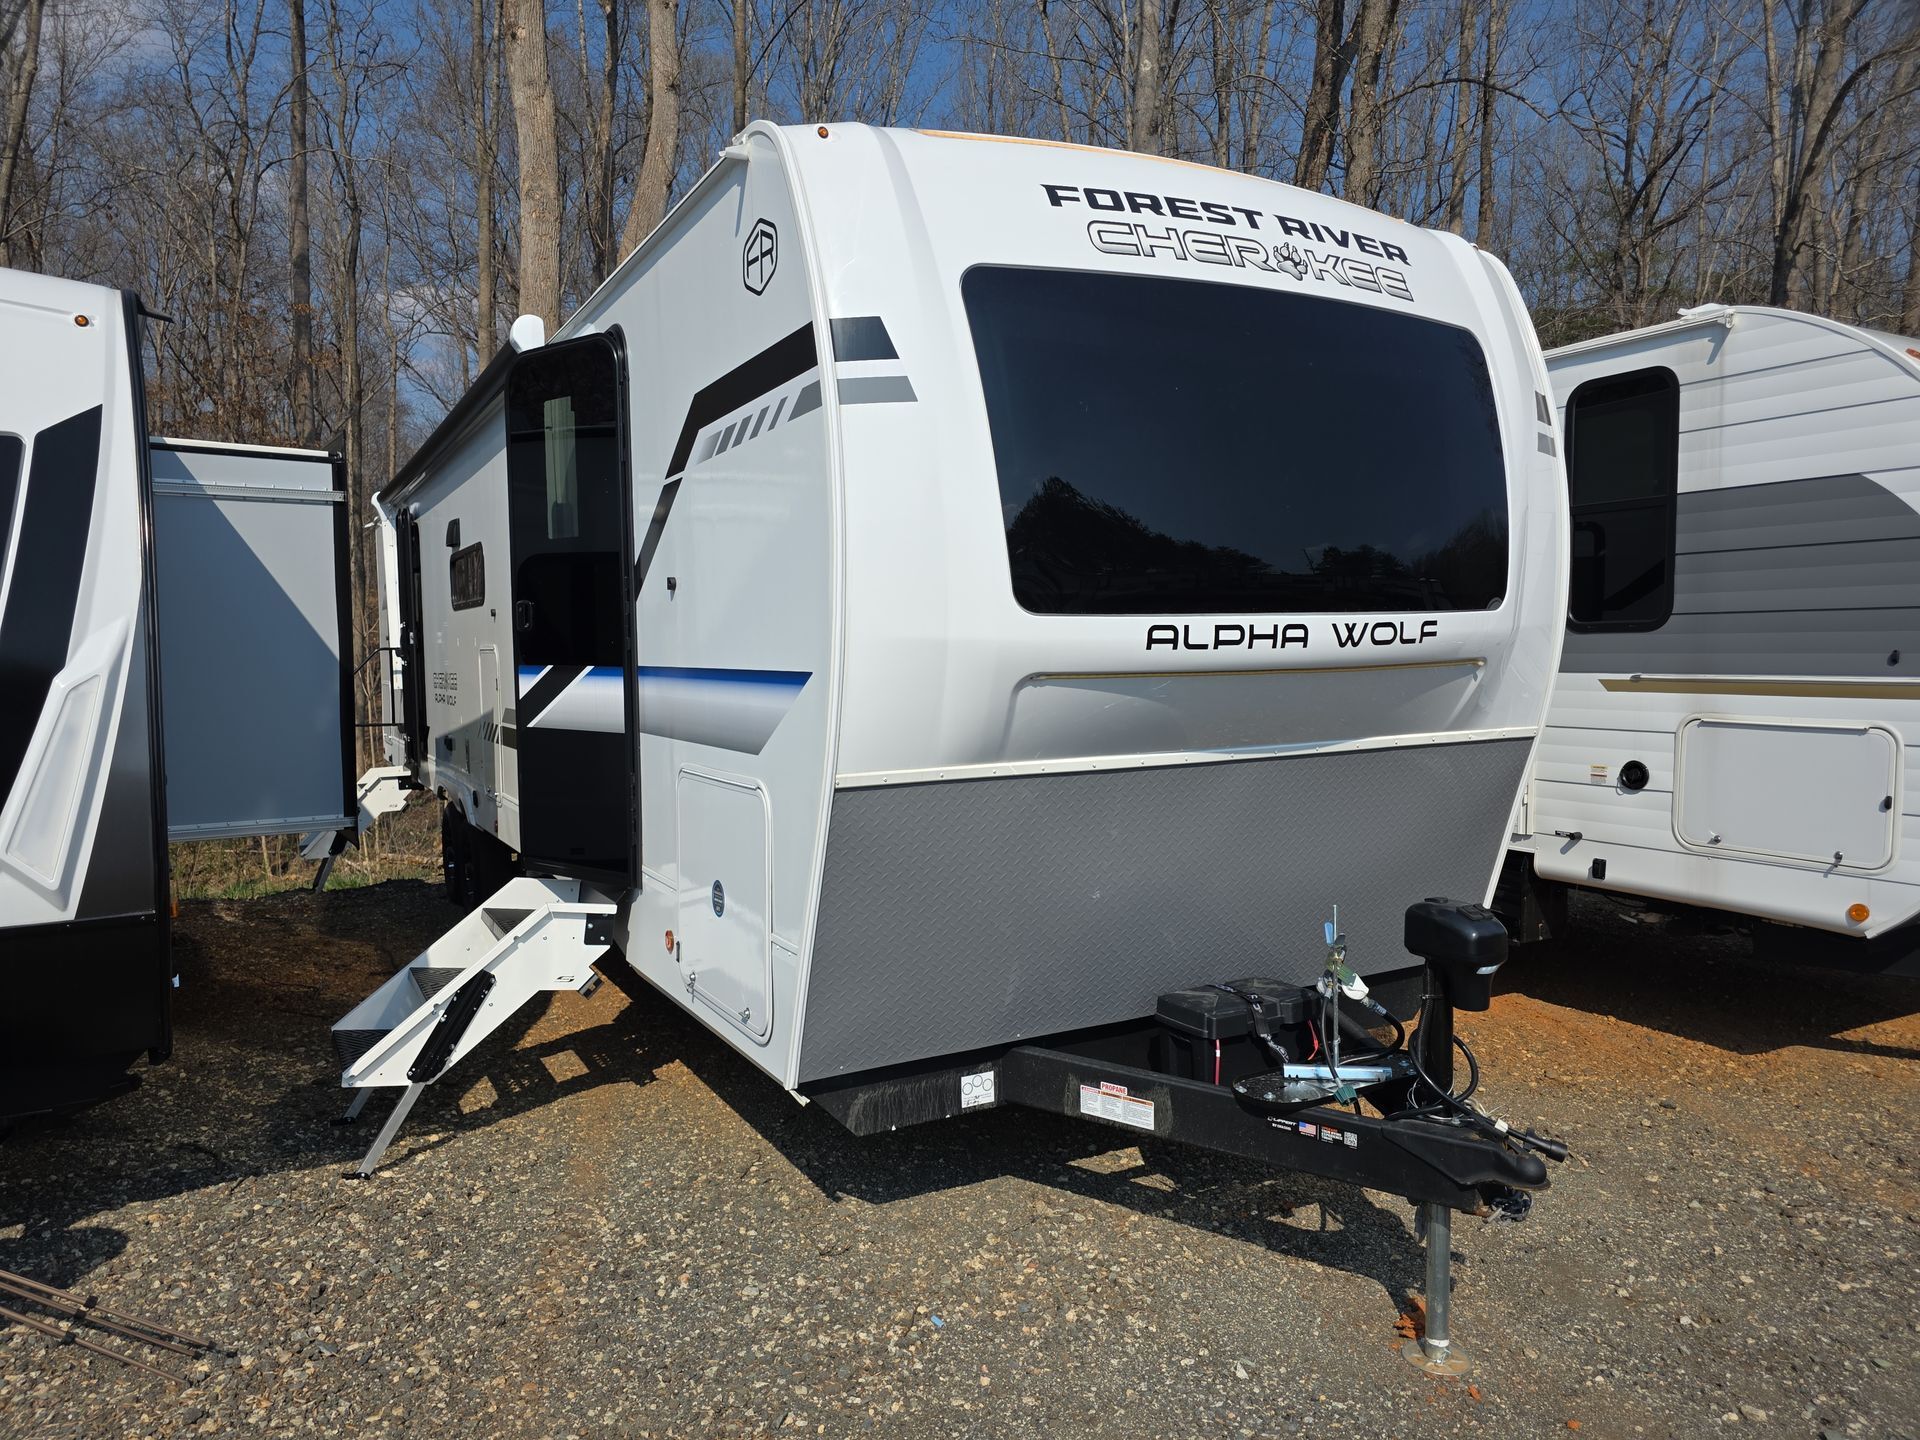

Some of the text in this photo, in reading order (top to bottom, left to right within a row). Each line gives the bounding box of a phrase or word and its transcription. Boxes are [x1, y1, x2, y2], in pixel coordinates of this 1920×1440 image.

[1040, 183, 1412, 266] FOREST RIVER
[1146, 620, 1437, 650] ALPHA WOLF
[1101, 1082, 1127, 1095] PROPANE
